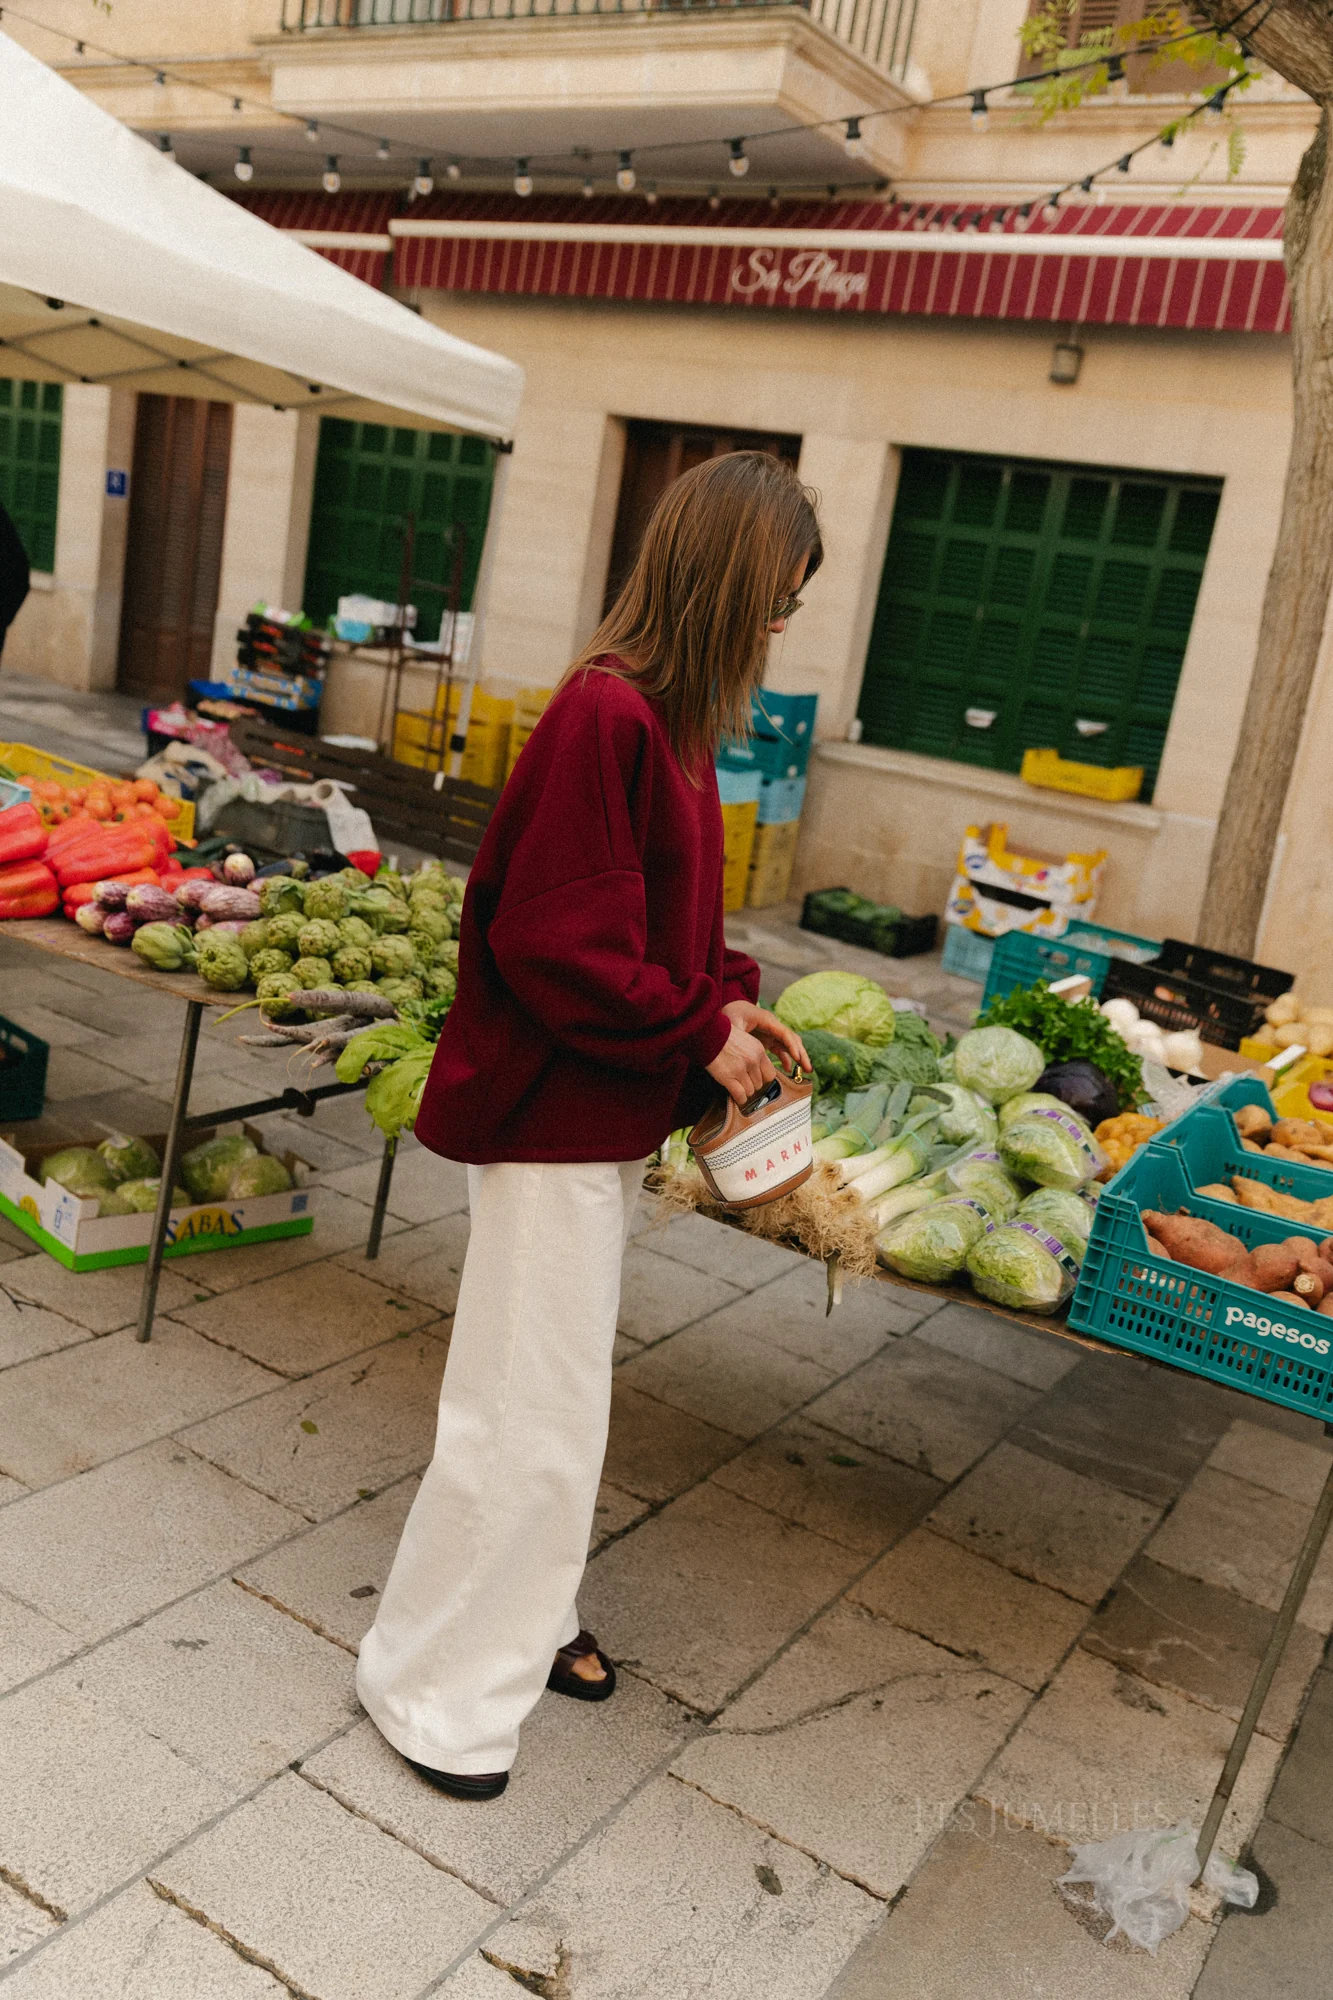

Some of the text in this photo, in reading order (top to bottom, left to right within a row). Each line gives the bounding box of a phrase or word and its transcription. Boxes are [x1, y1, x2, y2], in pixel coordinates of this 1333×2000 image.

[744, 1136, 809, 1181] MARNI
[163, 1209, 244, 1248] SABAS
[1225, 1307, 1331, 1354] pagesos
